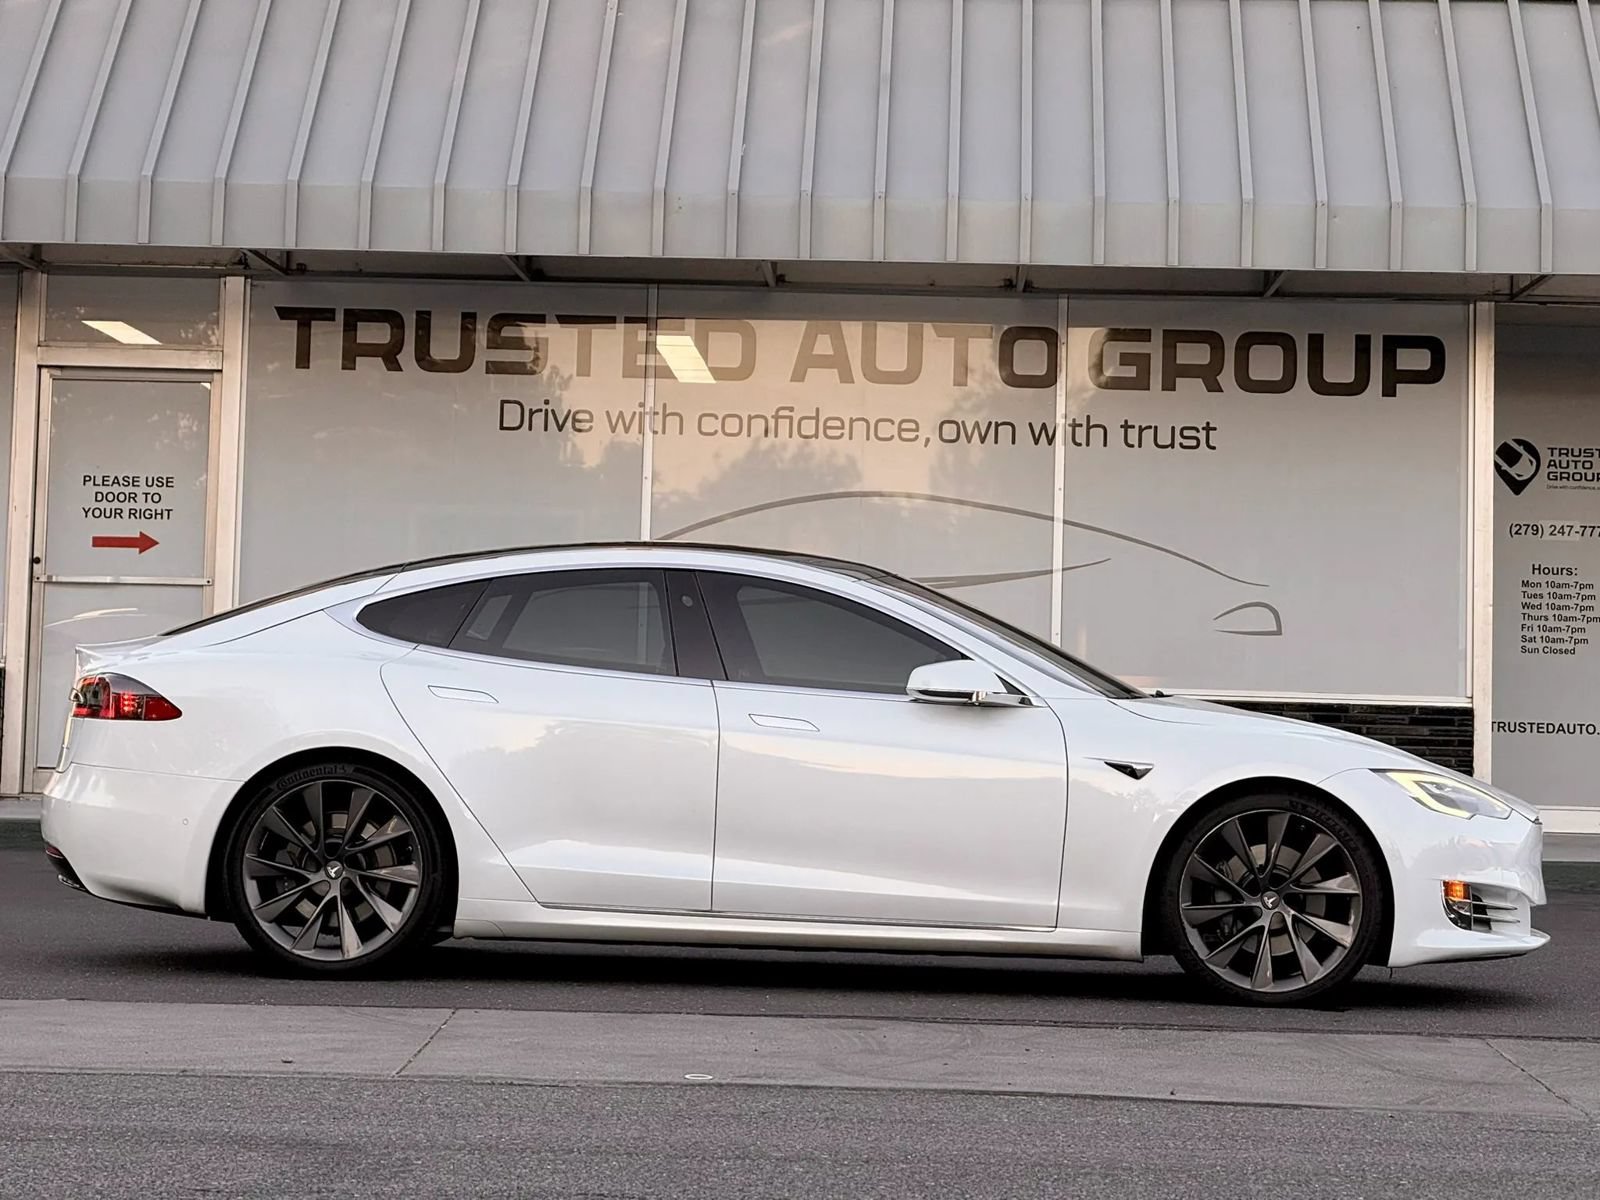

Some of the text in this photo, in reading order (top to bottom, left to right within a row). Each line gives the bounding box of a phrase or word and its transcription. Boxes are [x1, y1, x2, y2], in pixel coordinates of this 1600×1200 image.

[275, 306, 1446, 398] TRUSTED AUTO GROUP
[499, 399, 594, 433] Drive
[605, 402, 684, 436] with
[697, 405, 931, 448] confidence,
[938, 419, 1017, 446] own
[1120, 419, 1218, 451] trust
[1547, 459, 1594, 470] AUTO
[82, 474, 175, 488] PLEASE USE
[94, 491, 162, 504] DOOR TO
[82, 506, 174, 520] YOUR RIGHT
[1509, 523, 1544, 539] (279)
[1531, 563, 1578, 576] Hours:
[1521, 580, 1594, 591] Mon 10am-7pm
[1521, 591, 1596, 602] Tues 10am-7pm
[1521, 602, 1594, 613] Wed 10am-7pm
[1521, 613, 1600, 624] Thurs 10am-7pm
[1521, 624, 1586, 635] Fri 10am-7pm
[1520, 634, 1589, 646] Sat 10am-7pm
[1520, 645, 1576, 655] Sun Closed
